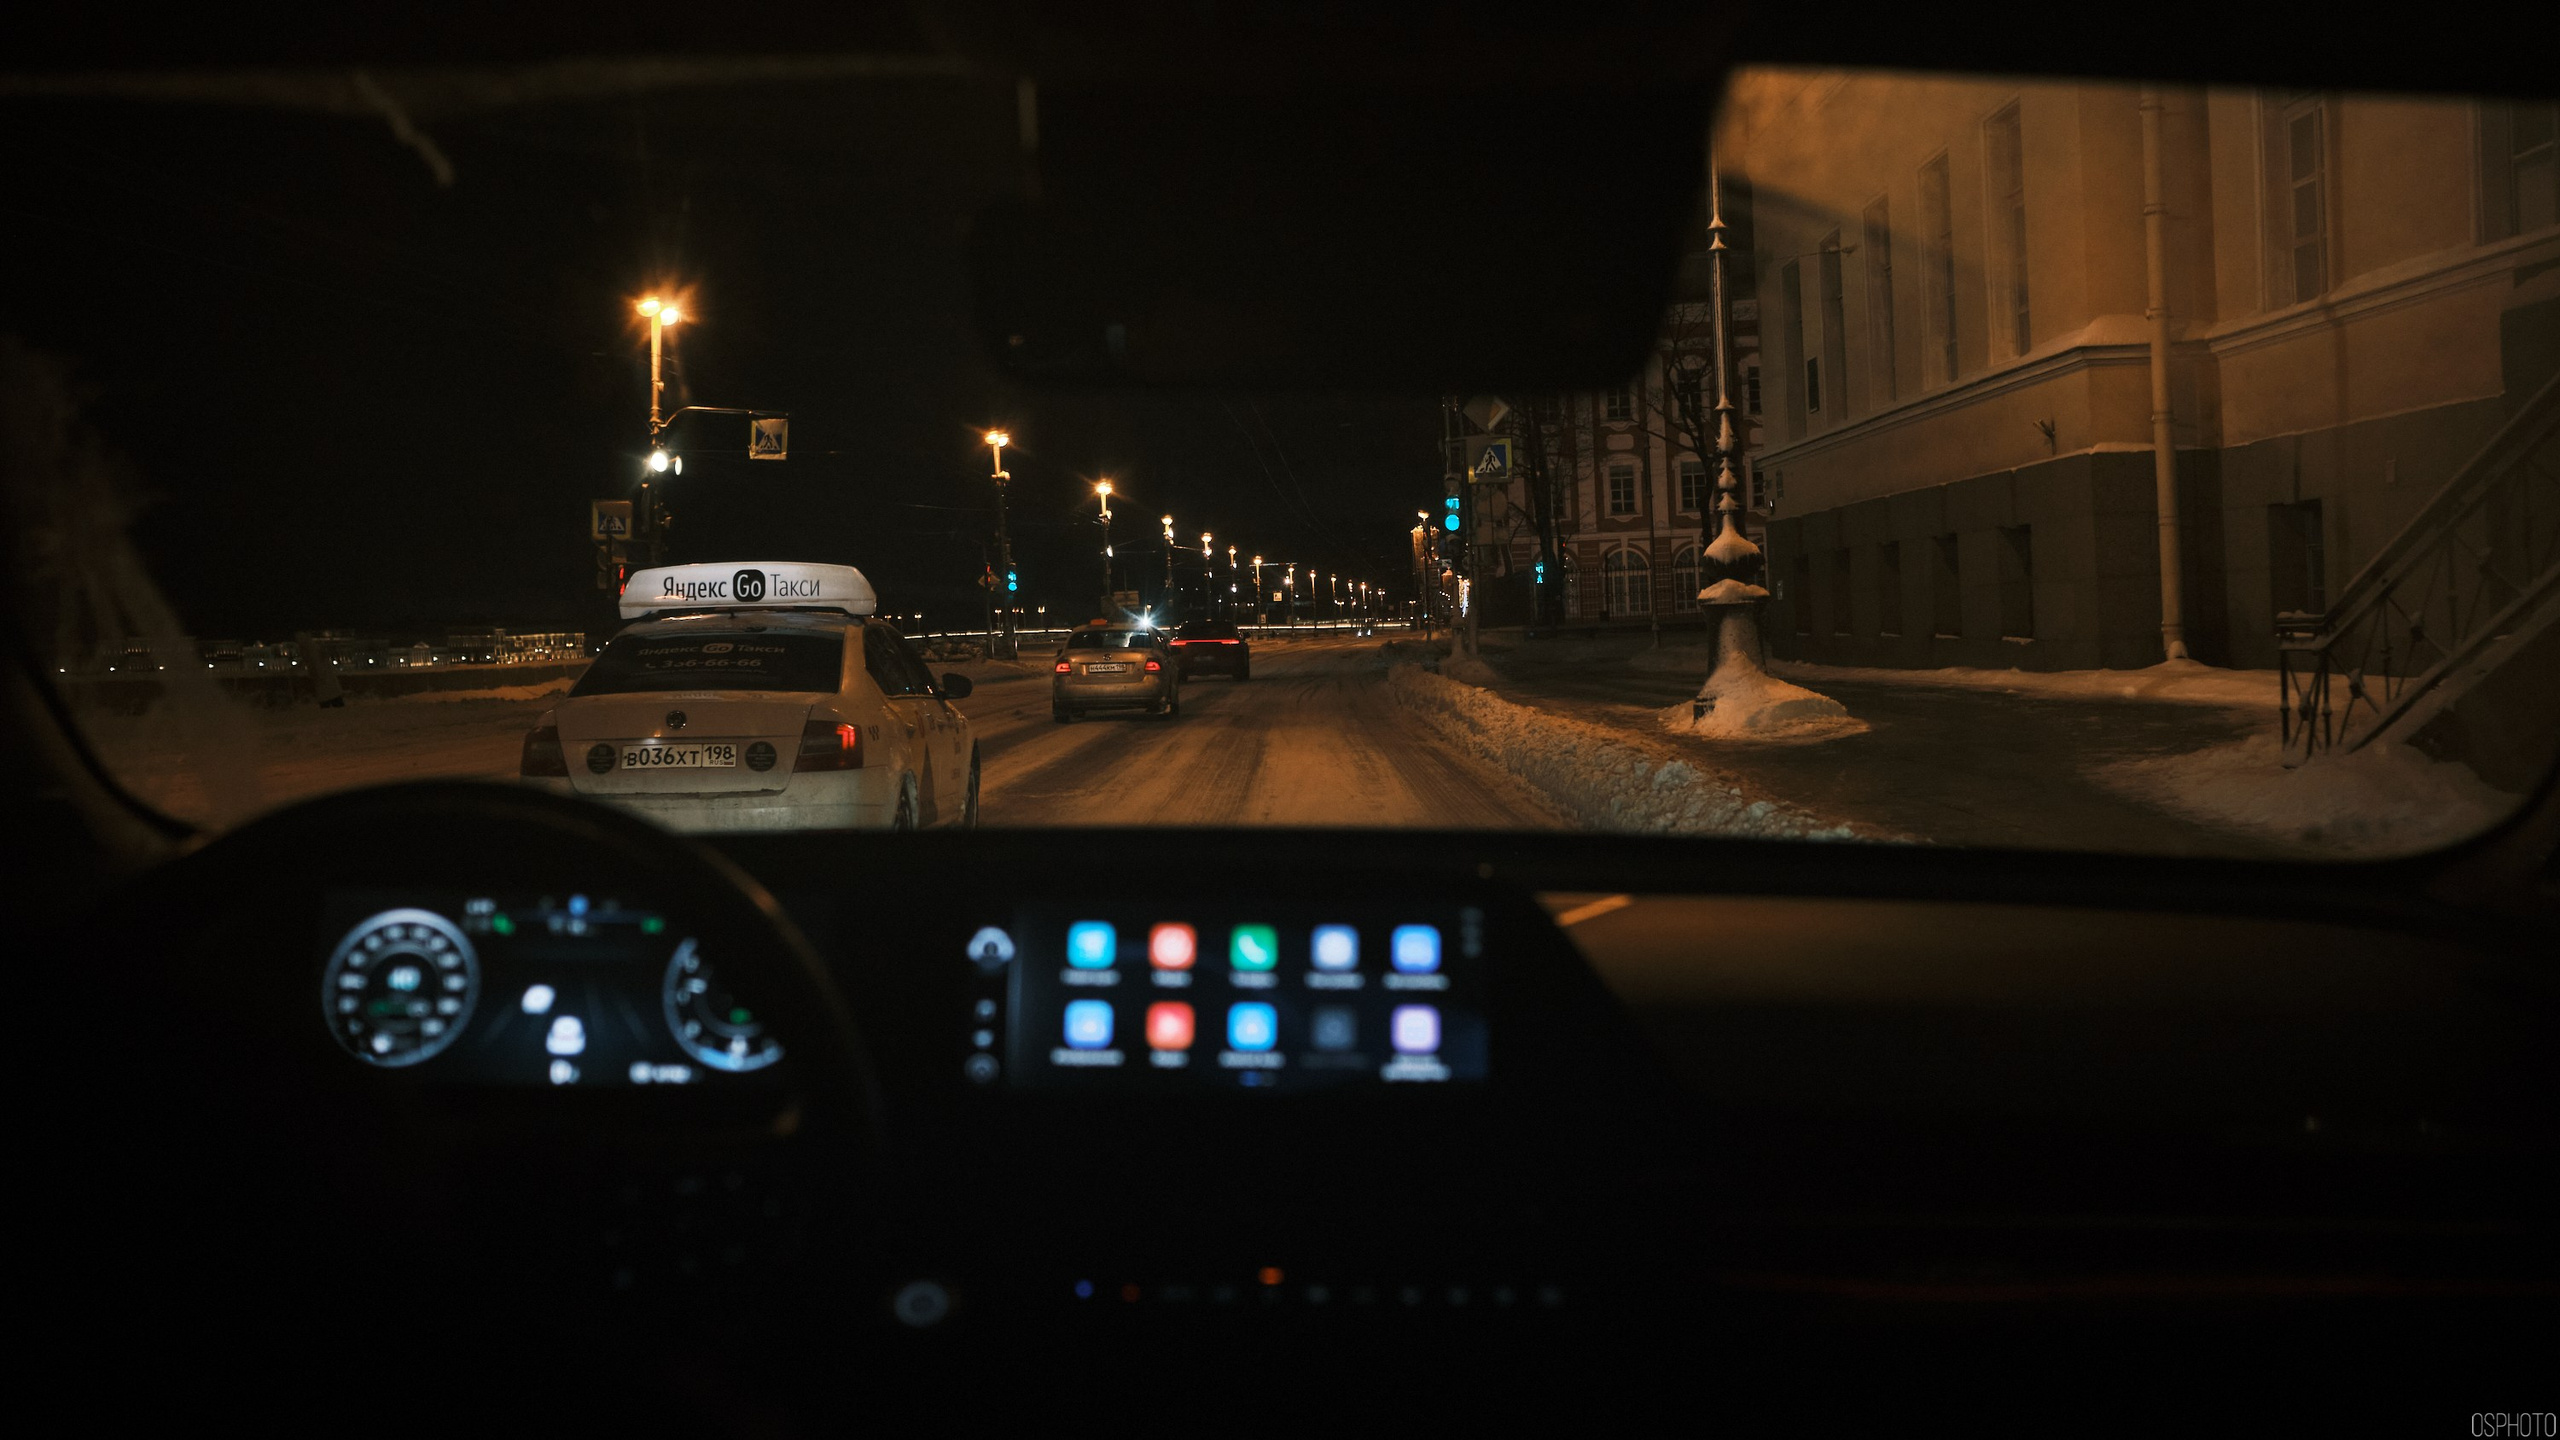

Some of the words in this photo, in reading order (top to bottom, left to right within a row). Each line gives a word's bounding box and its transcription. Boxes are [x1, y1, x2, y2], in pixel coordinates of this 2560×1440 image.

[663, 576, 727, 601] Яндекс
[736, 573, 762, 598] Go
[770, 574, 820, 597] Такси
[737, 644, 786, 654] Такси
[627, 747, 700, 766] В036ХТ
[705, 746, 732, 760] 198
